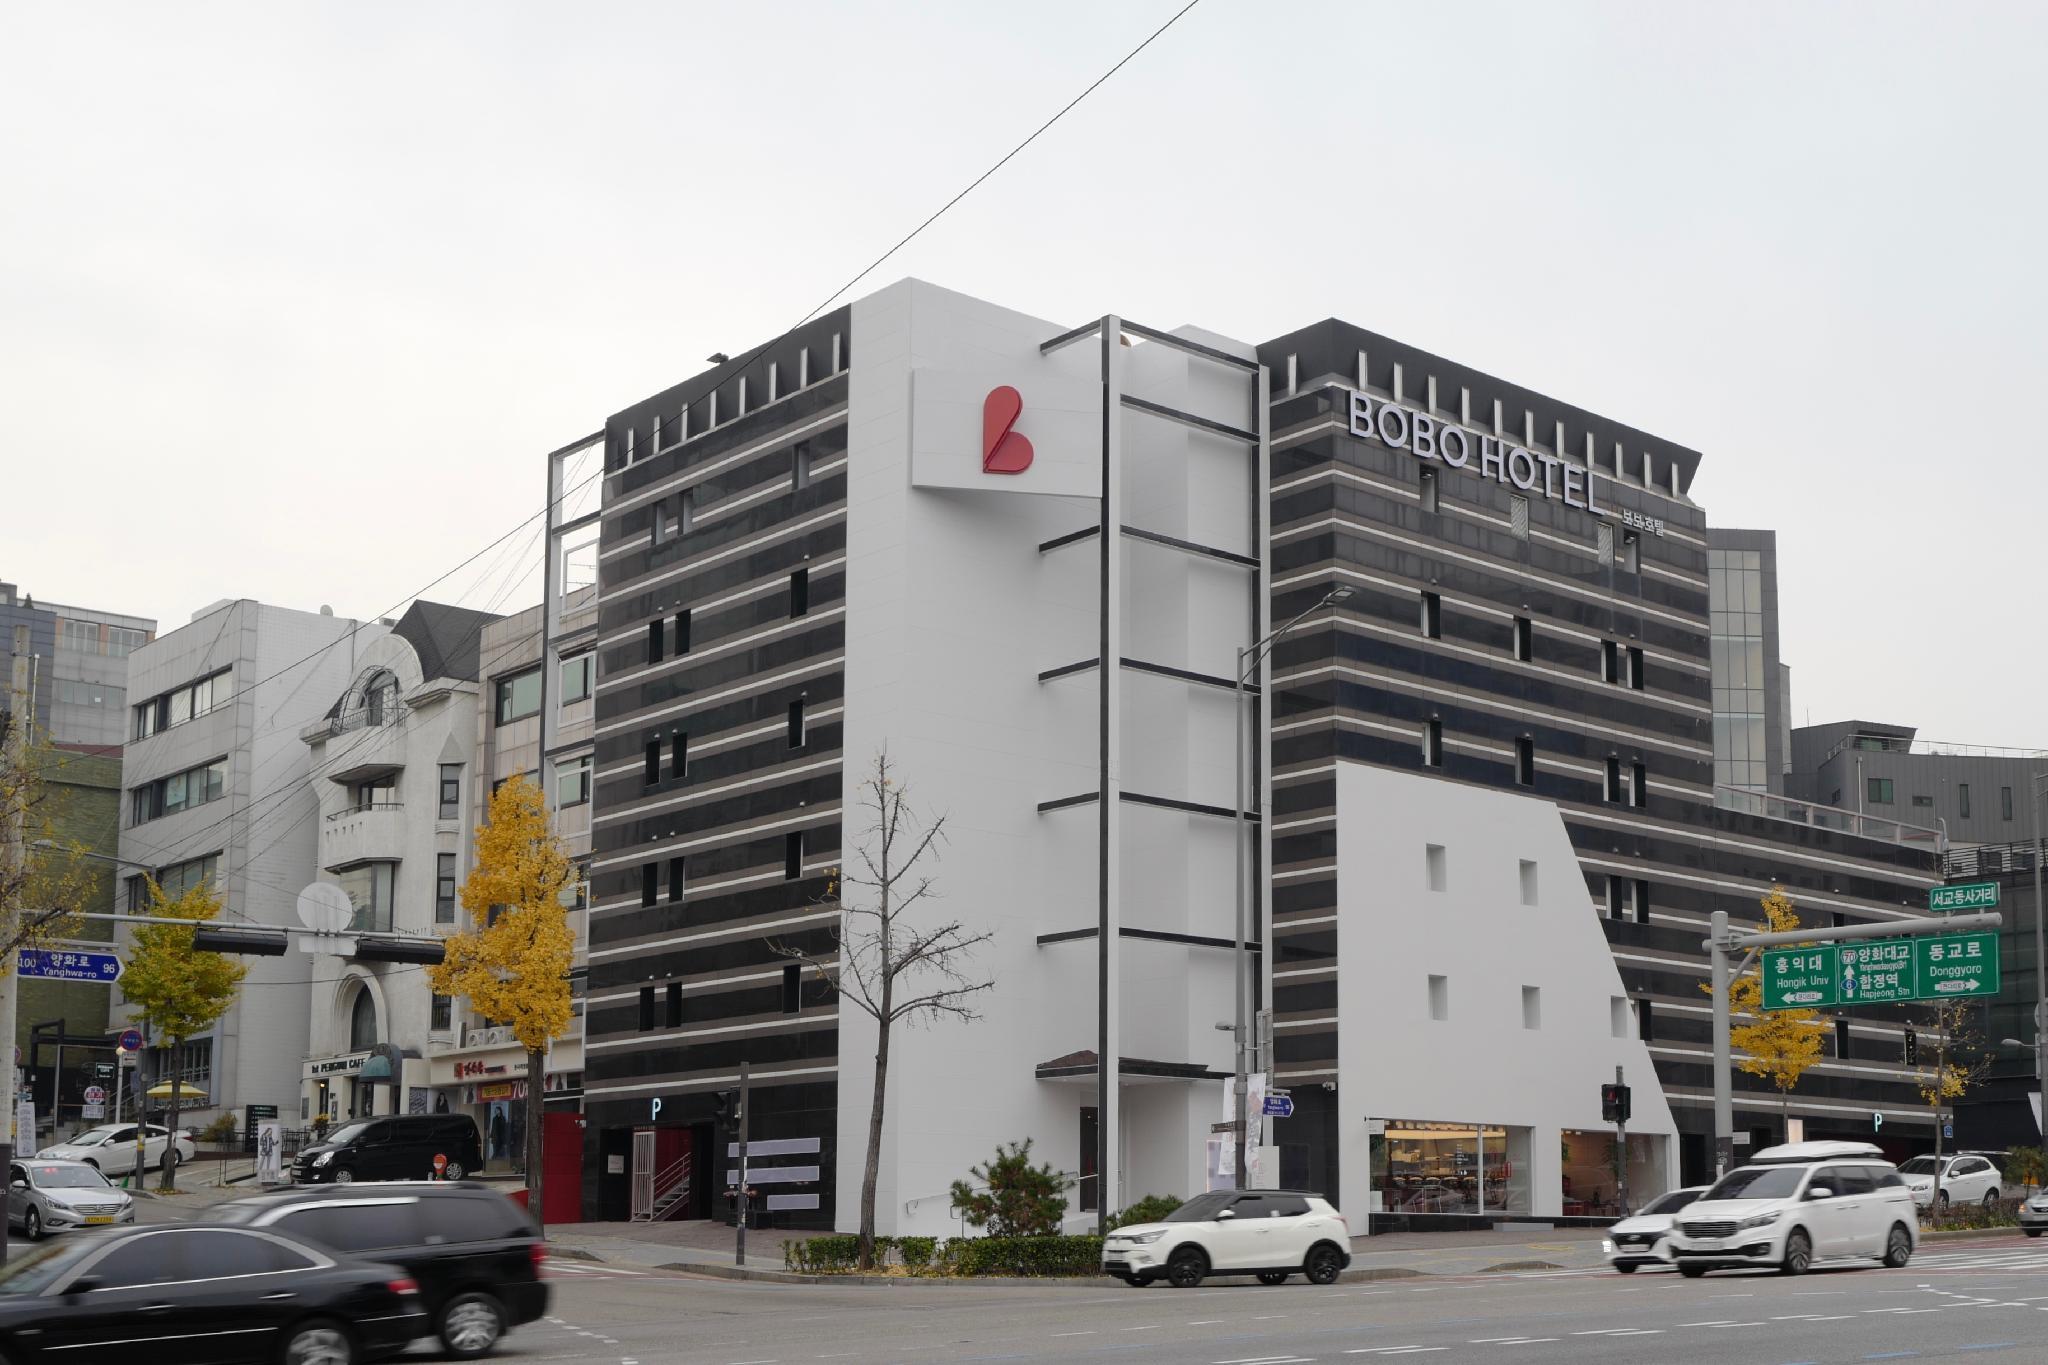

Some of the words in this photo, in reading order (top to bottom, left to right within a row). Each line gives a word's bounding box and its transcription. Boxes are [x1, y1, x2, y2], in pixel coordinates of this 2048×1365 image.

[1350, 390, 1469, 468] BOBO
[1481, 434, 1608, 516] HOTEL
[1622, 508, 1664, 537] 보보호텔
[1933, 887, 1995, 906] 서교동사거리
[51, 953, 91, 967] 양화로
[1858, 945, 1910, 963] 양화대교
[1929, 942, 1982, 961] 동교로
[42, 966, 97, 979] Yanghwa-ro
[103, 963, 115, 974] 96
[1775, 954, 1823, 974] 홍익대
[1929, 964, 1982, 979] Donggyoro
[1777, 977, 1807, 990] Hongik
[1810, 976, 1829, 986] Univ
[1859, 973, 1899, 990] 합정역
[1859, 989, 1895, 1000] Hapjeong
[1898, 987, 1910, 996] Stn
[652, 1098, 662, 1121] P
[1873, 1112, 1883, 1133] P
